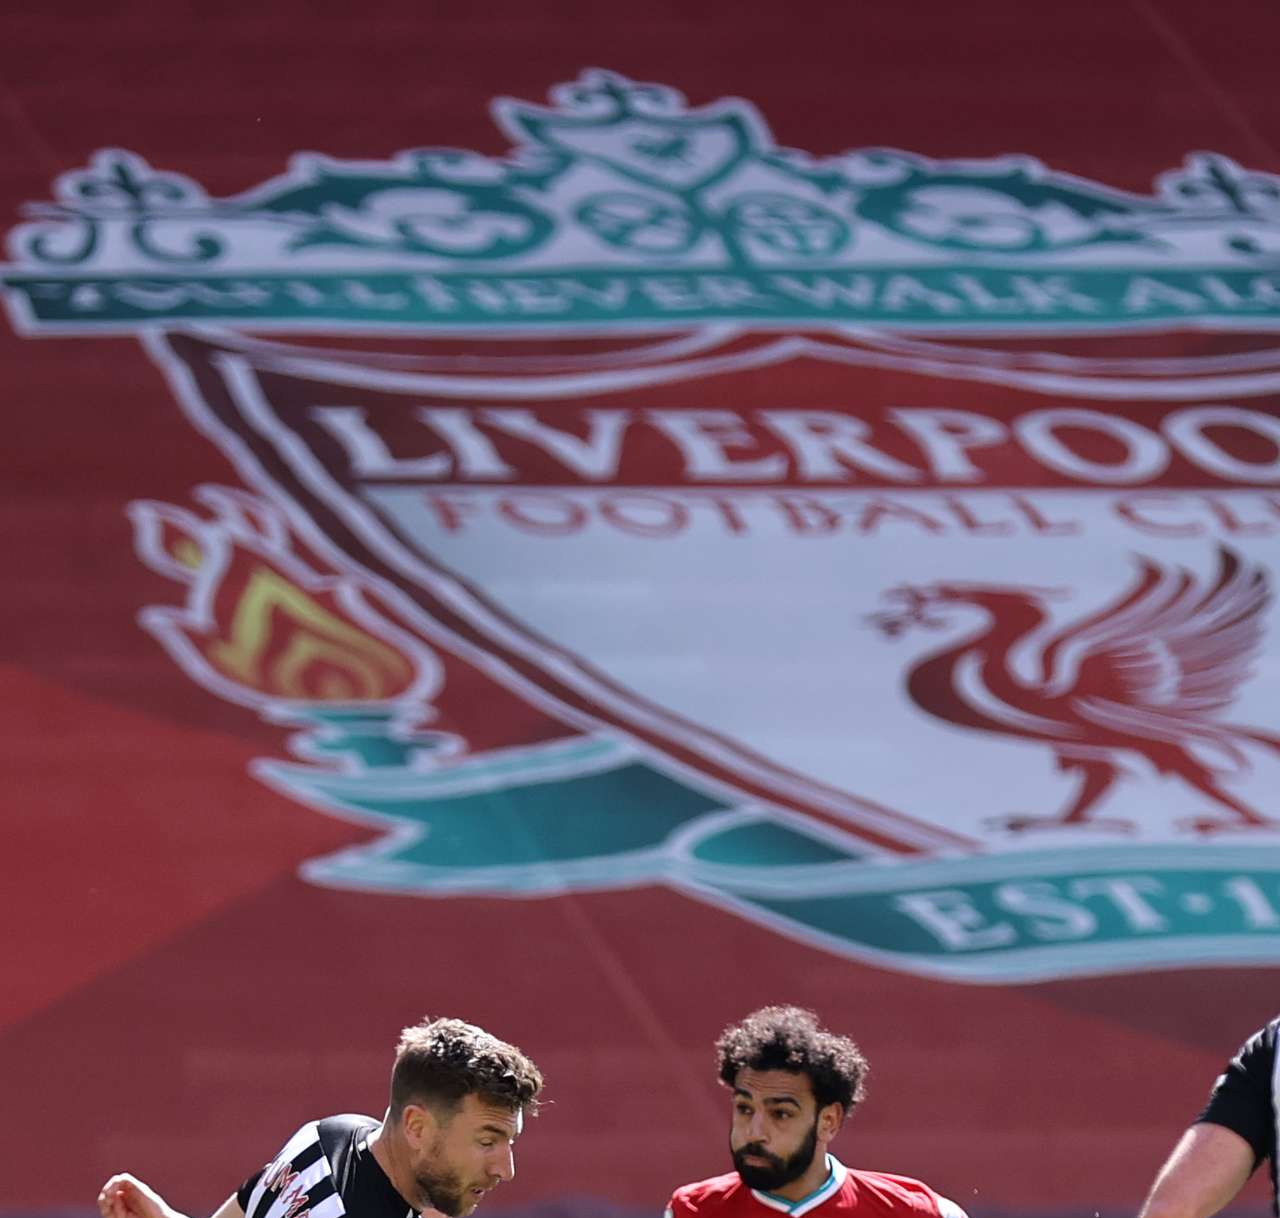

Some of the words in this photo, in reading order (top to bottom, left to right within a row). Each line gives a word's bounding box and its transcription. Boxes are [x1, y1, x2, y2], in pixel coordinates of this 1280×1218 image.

[770, 273, 1102, 314] WALK
[422, 488, 1082, 541] FOOTBALL
[894, 875, 1170, 953] EST
